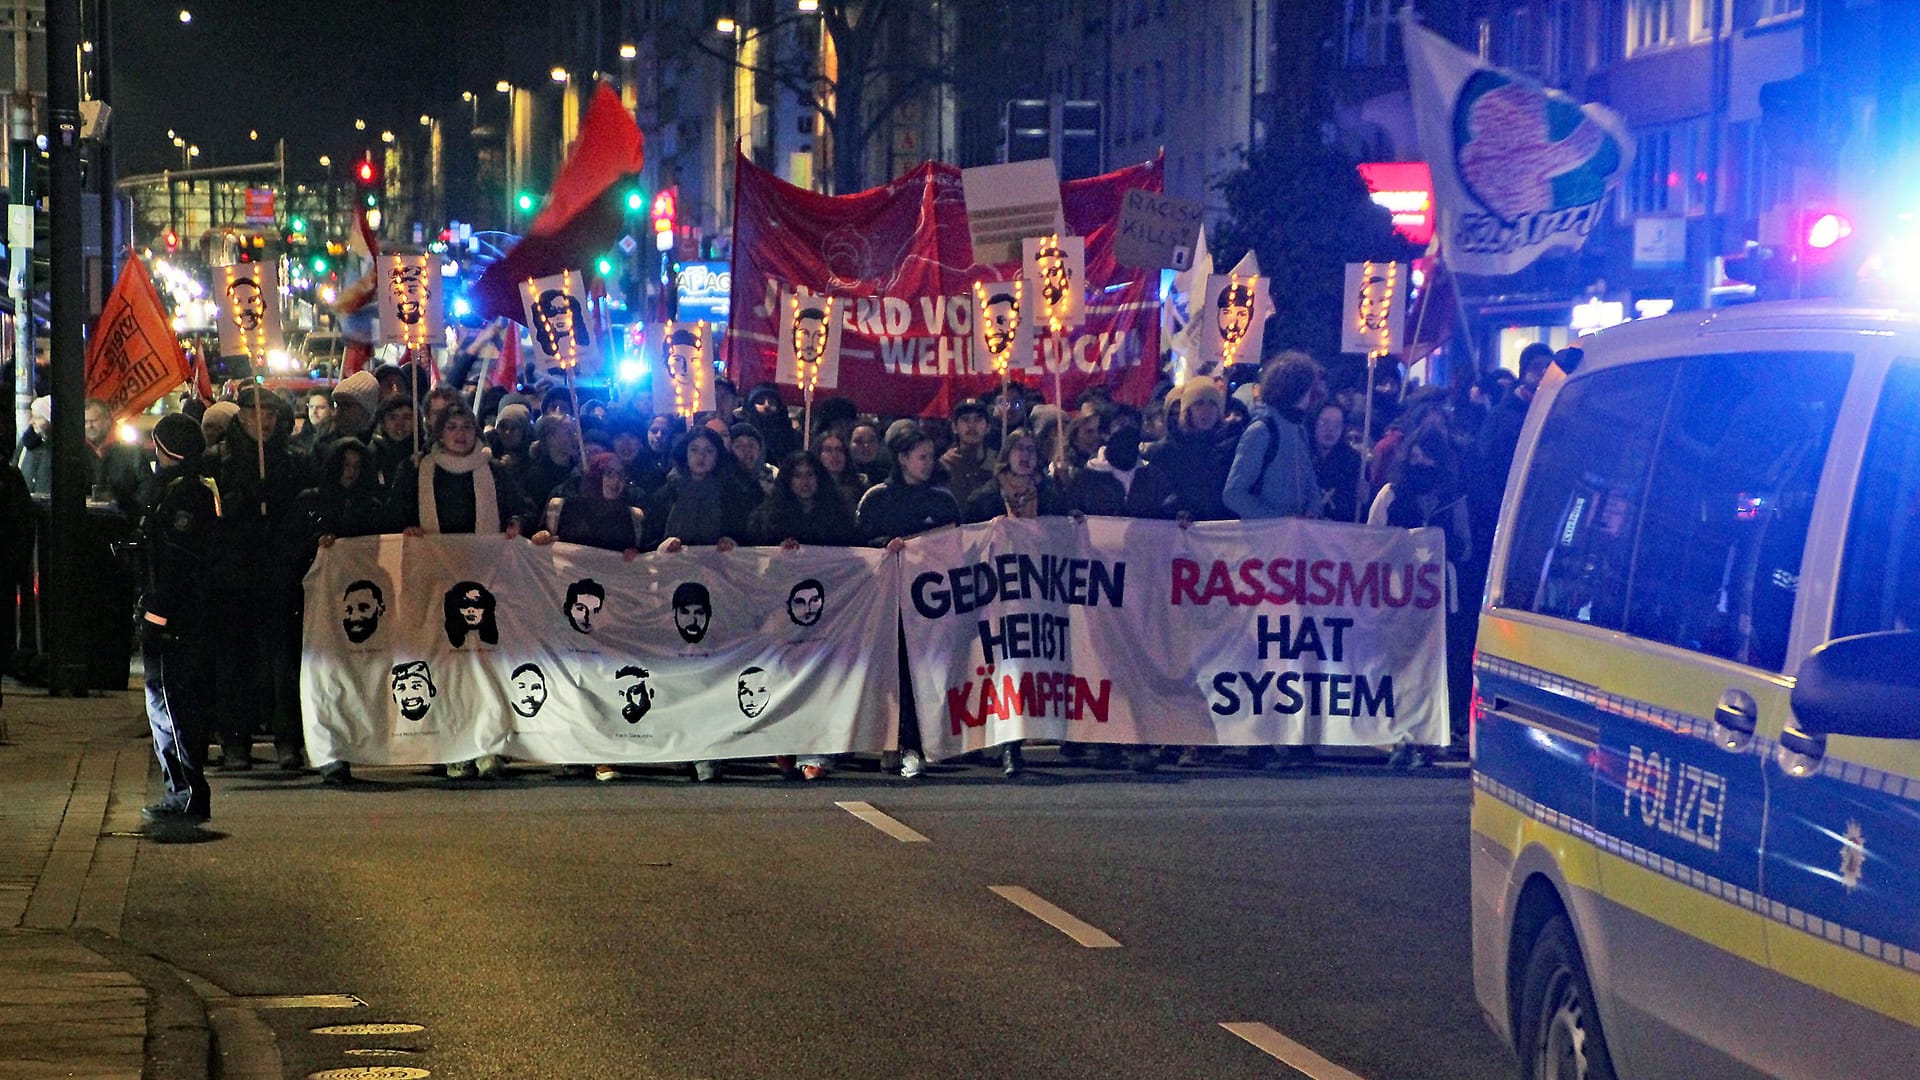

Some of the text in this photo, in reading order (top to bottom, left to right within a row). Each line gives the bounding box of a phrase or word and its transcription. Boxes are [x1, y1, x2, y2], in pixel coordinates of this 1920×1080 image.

[911, 554, 1126, 620] GEDENKEN
[1171, 558, 1442, 609] RASSISMUS
[1257, 615, 1354, 662] HAT
[947, 664, 1112, 736] KÄMPFEN
[1211, 671, 1395, 718] SYSTEM
[1624, 744, 1727, 853] POLIZEI
